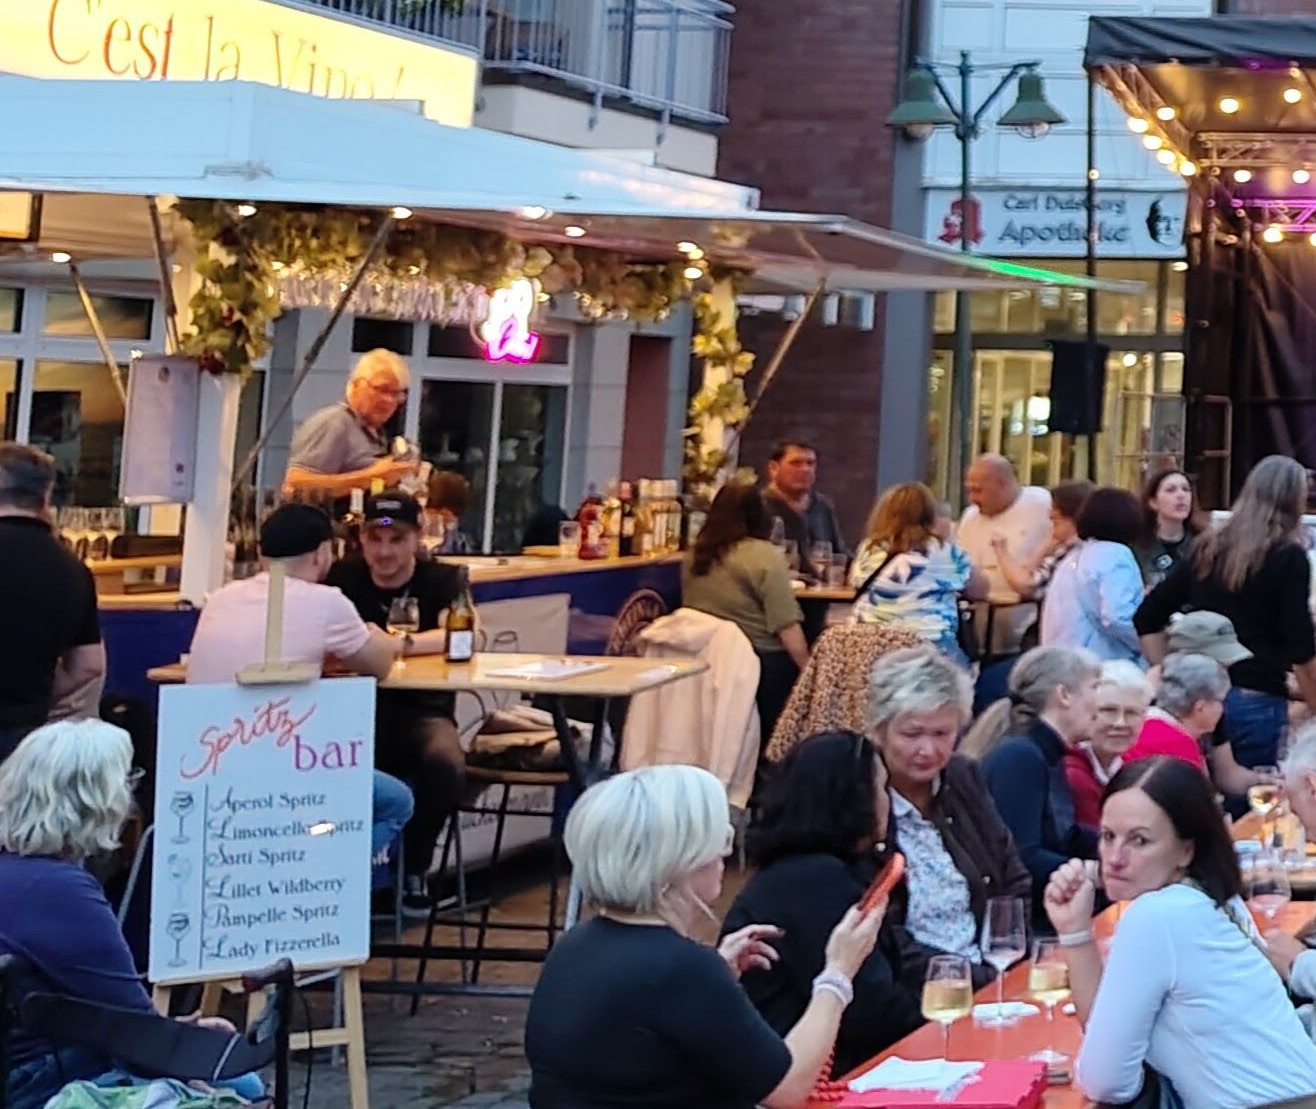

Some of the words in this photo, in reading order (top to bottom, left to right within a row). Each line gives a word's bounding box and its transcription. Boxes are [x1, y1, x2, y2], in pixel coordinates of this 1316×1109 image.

[202, 15, 241, 82] la
[180, 696, 317, 778] Spritz
[294, 735, 363, 772] bar
[210, 786, 274, 813] Aperol
[278, 793, 326, 809] Spritz
[318, 820, 364, 837] pritz
[257, 848, 306, 868] Spritz
[205, 874, 261, 900] Lillet
[267, 877, 346, 896] Wildberry
[208, 902, 287, 928] Pampelle
[291, 903, 340, 923] Spritz
[204, 936, 259, 961] Lady
